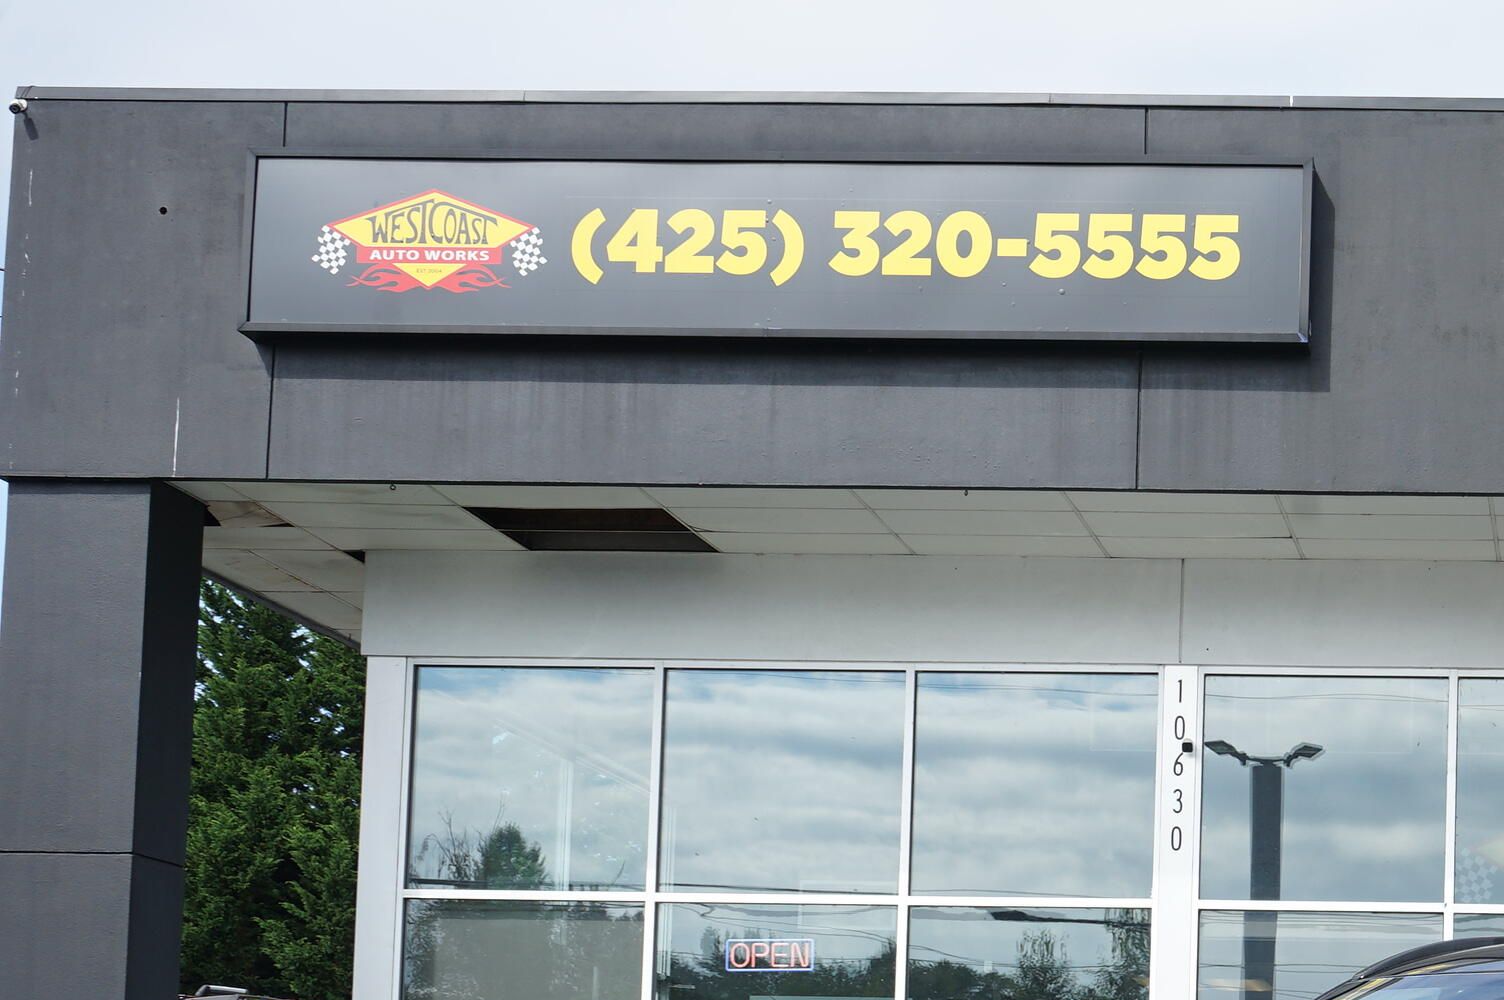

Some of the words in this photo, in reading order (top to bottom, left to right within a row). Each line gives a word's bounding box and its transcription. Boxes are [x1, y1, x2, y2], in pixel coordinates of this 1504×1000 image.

[370, 250, 419, 261] AUTO
[425, 250, 490, 261] WORKS
[572, 208, 804, 286] (425)
[828, 210, 1240, 281] 320-5555
[730, 942, 809, 968] OPEN
